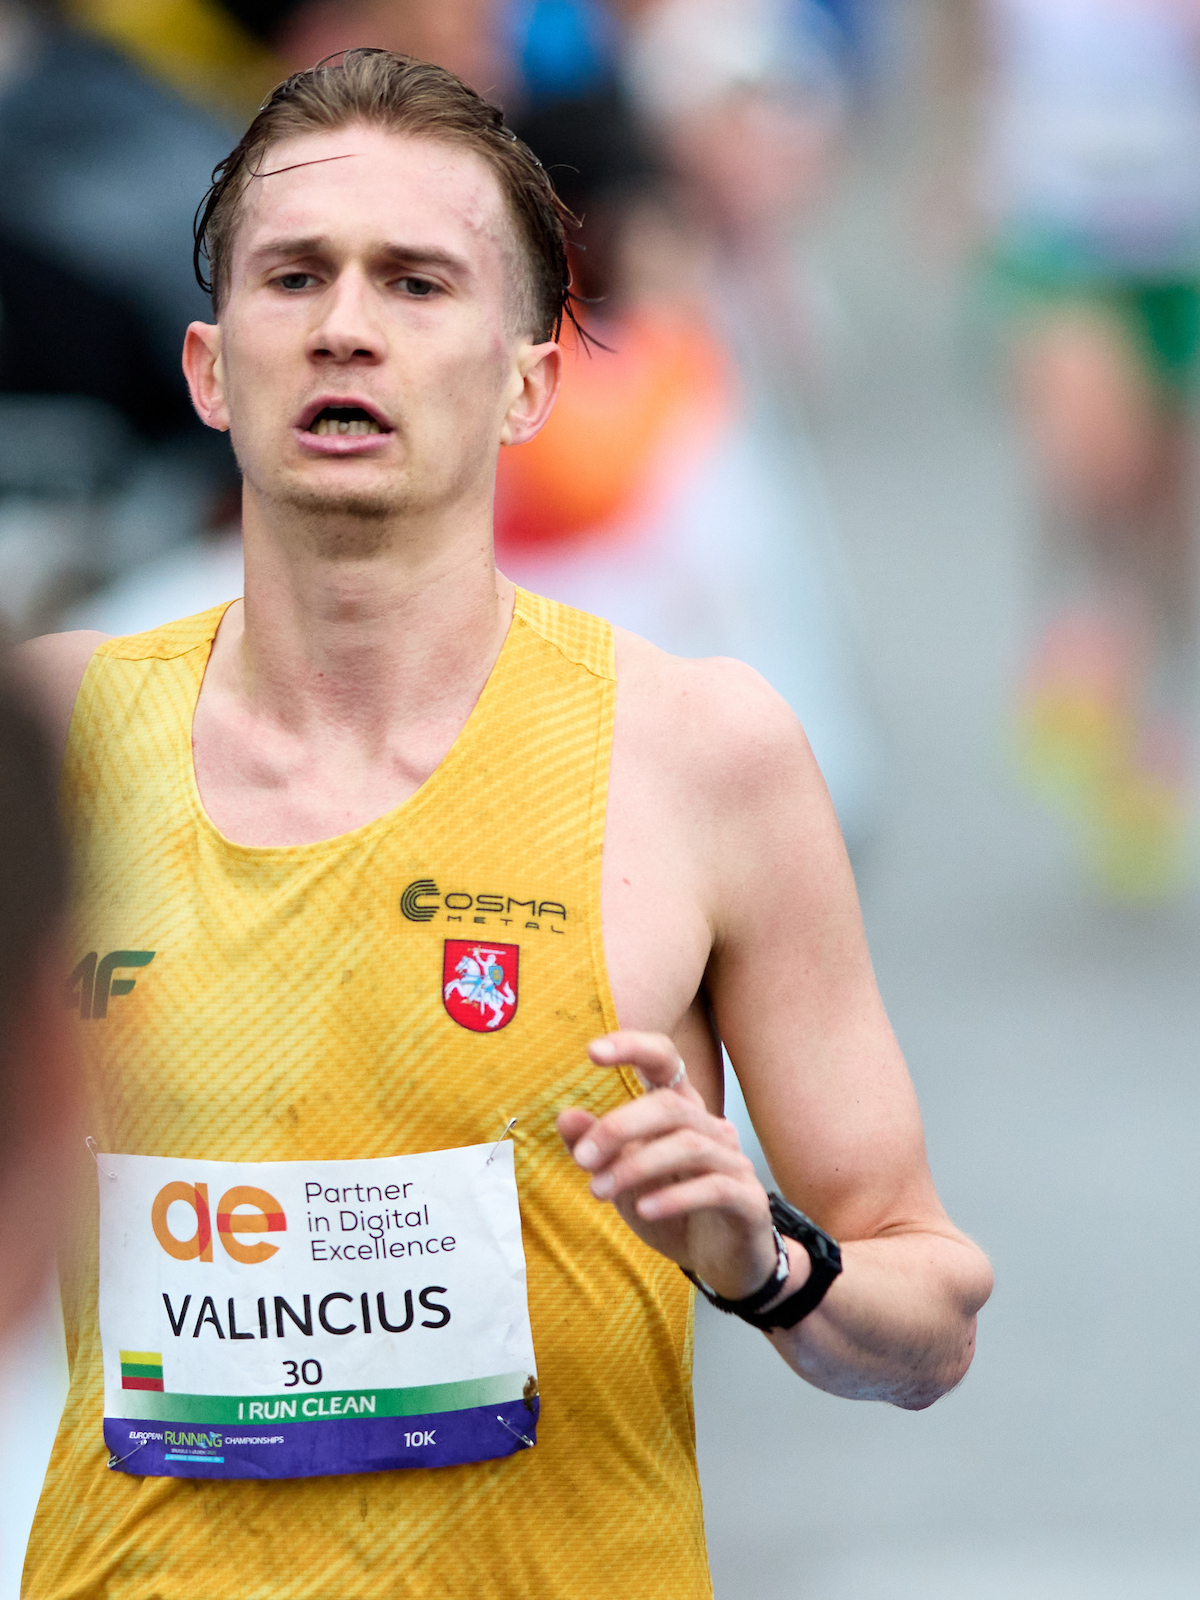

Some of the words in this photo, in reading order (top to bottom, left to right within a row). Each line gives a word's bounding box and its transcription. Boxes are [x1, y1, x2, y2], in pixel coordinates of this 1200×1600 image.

[400, 879, 567, 921] COSMA
[447, 915, 565, 934] METAL
[305, 1181, 414, 1203] Partner
[151, 1180, 287, 1264] ae
[307, 1211, 330, 1232] in
[340, 1204, 429, 1239] Digital
[311, 1235, 456, 1261] Excellence
[162, 1285, 451, 1340] VALINCIUS
[282, 1358, 323, 1387] 30
[237, 1402, 244, 1420] I
[250, 1399, 297, 1420] RUN
[302, 1395, 377, 1416] CLEAN
[128, 1431, 163, 1441] EUROPEAN
[164, 1430, 223, 1448] RUNNING
[224, 1435, 285, 1445] CHAMPIONSHIPS
[404, 1429, 436, 1448] 10K
